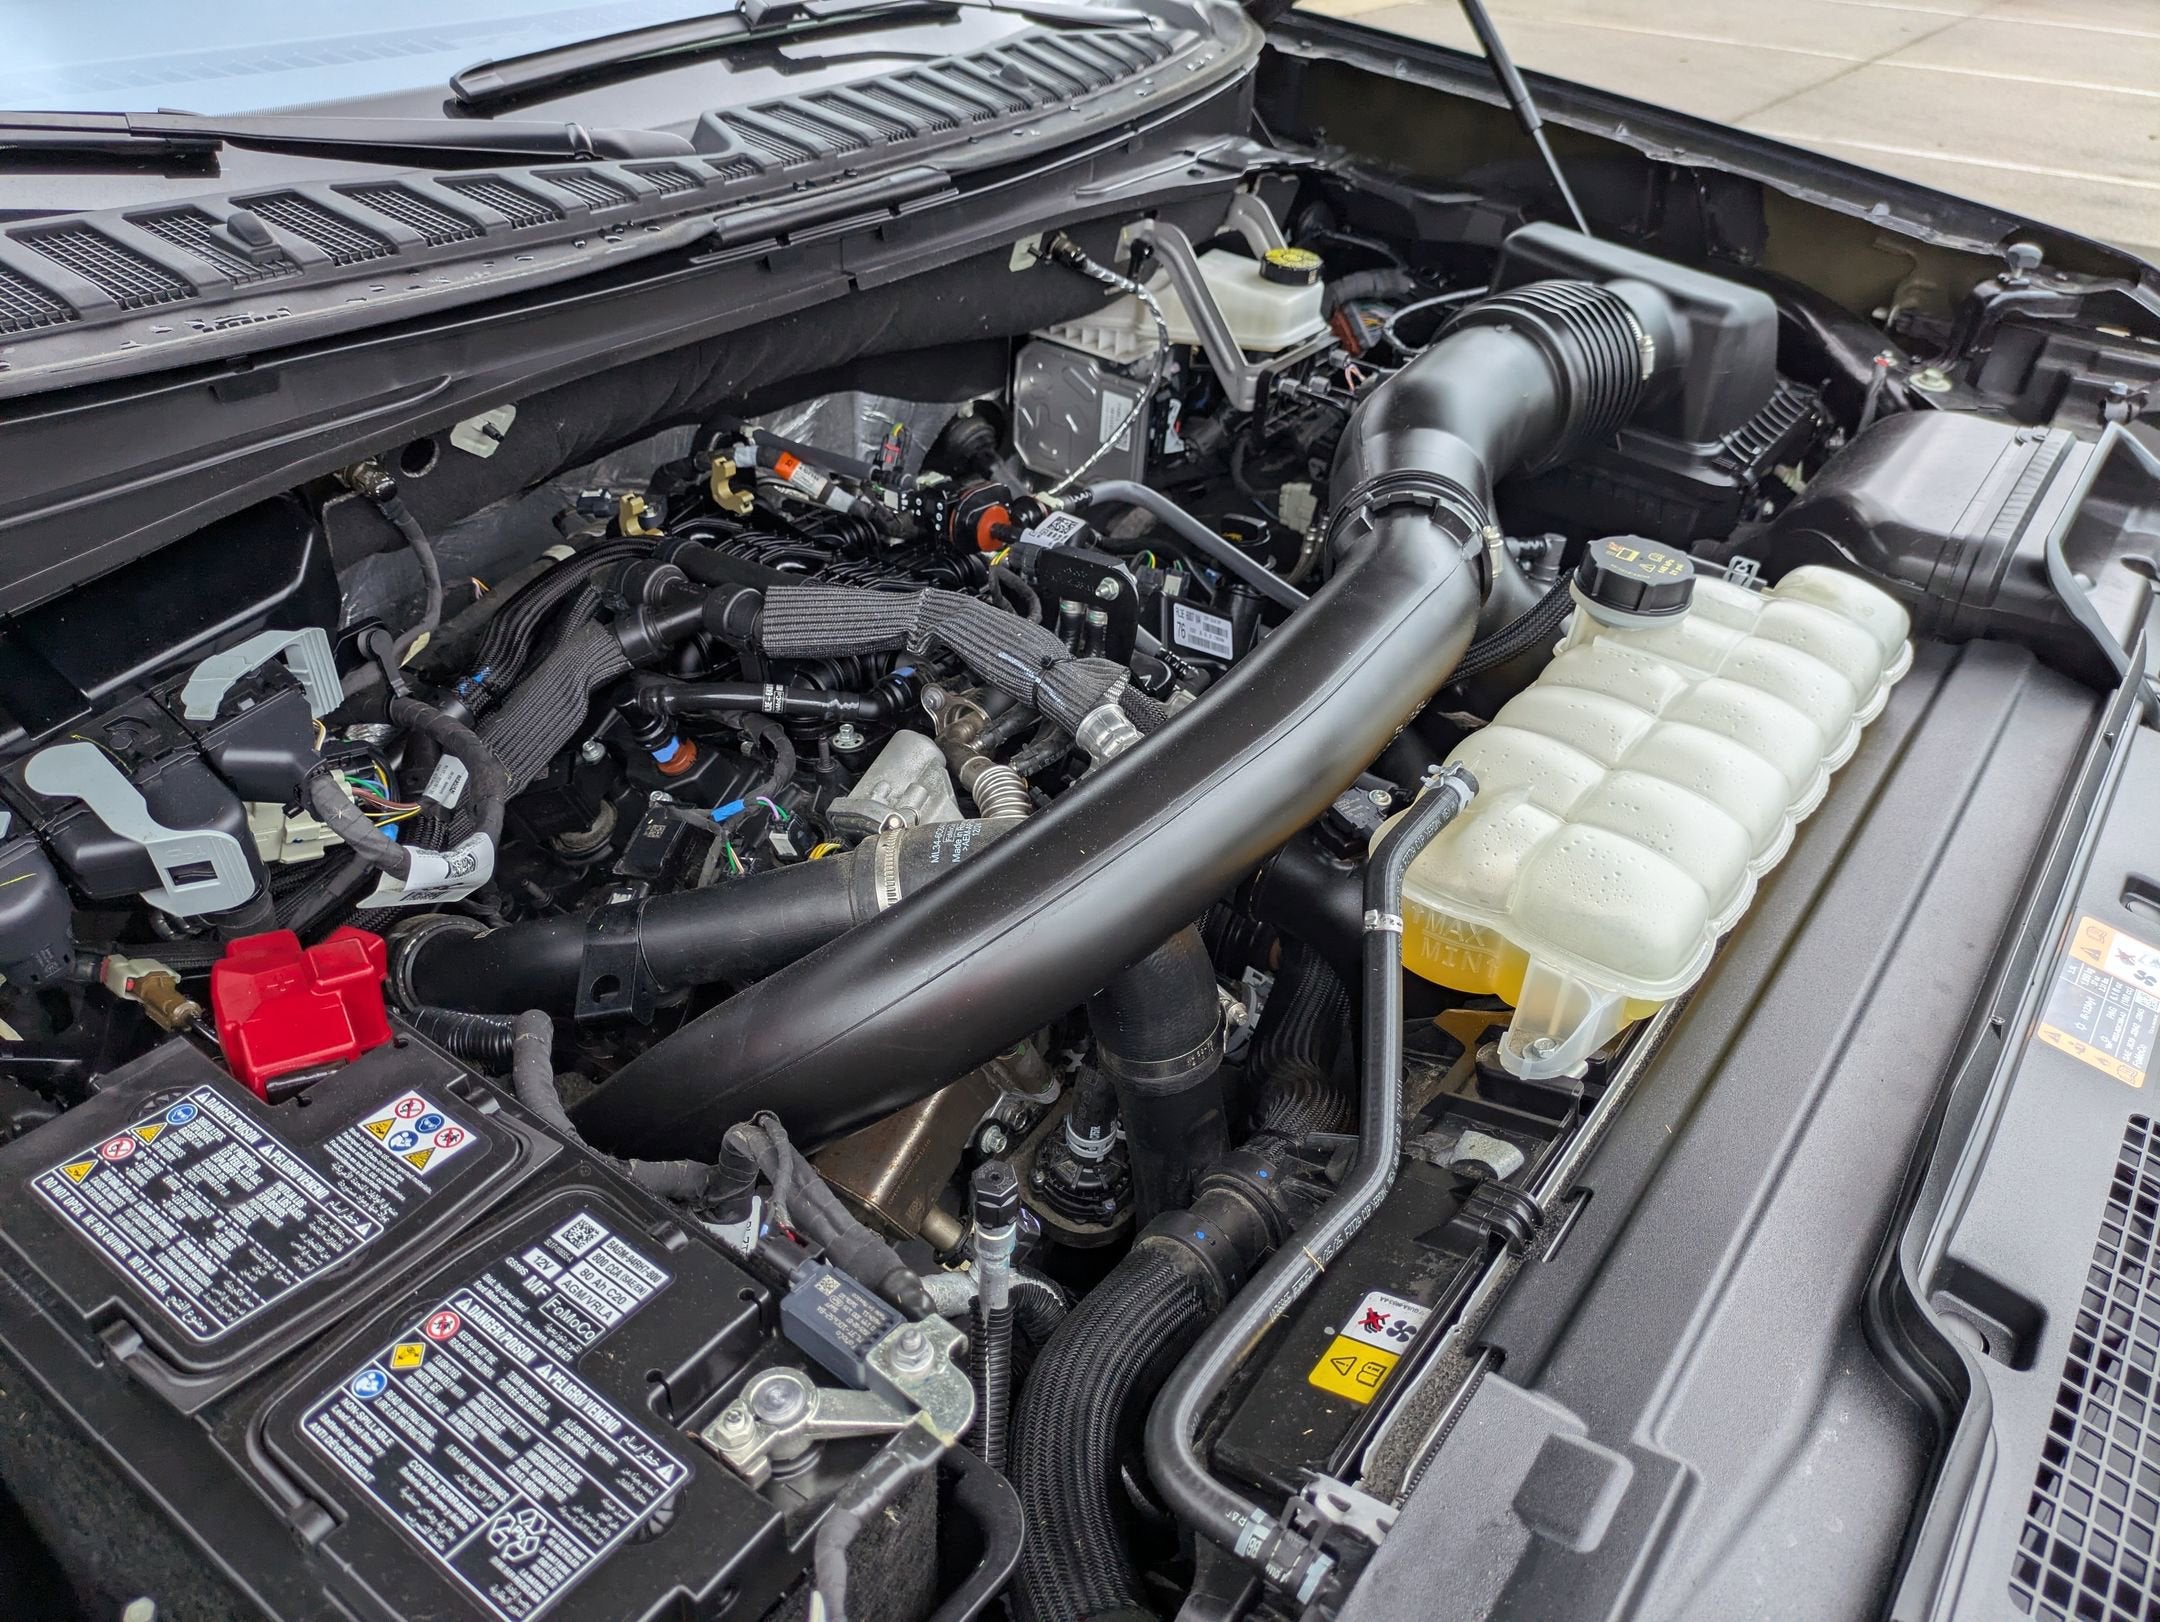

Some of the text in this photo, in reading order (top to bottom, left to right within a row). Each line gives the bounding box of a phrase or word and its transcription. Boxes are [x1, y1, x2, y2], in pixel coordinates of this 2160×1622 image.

[1174, 620, 1188, 639] 76
[951, 838, 963, 863] Made
[1423, 910, 1489, 947] MAX
[1418, 936, 1484, 974] MIN
[201, 1096, 264, 1144] DANGER/POISON
[265, 1149, 332, 1200] PELIGRO/VENENO
[40, 1176, 89, 1217] DO NOT OPEN.
[81, 1213, 99, 1226] NE
[89, 1221, 110, 1237] PAS
[100, 1231, 135, 1260] OUVRIR.
[530, 1254, 554, 1272] 12V
[125, 1255, 174, 1297] NO LA ABRA.
[520, 1273, 554, 1300] MF
[577, 1267, 629, 1305] 80 Ah C20
[590, 1253, 649, 1296] 800 CCA (SAE/EN)
[559, 1278, 616, 1321] AGM/VRLA
[543, 1297, 600, 1342] FoMoCo
[463, 1304, 539, 1364] DANGER/POISON
[544, 1370, 624, 1434] PELIGRO/VENENO
[371, 1395, 391, 1412] LIRE
[383, 1406, 401, 1421] LES
[382, 1388, 404, 1407] READ
[317, 1411, 375, 1466] Batterie au plomb
[329, 1403, 388, 1458] Lead Acid Battery
[338, 1396, 396, 1447] NON-SPILLABLE
[307, 1420, 377, 1483] ANTI DÉVERSEMENT
[443, 1442, 461, 1458] LEA
[453, 1452, 471, 1467] LAS
[405, 1457, 441, 1488] CONTRA
[434, 1483, 480, 1525] DERRAMES
[418, 1484, 431, 1496] de
[423, 1490, 448, 1512] plomo
[509, 1524, 529, 1541] Pb
